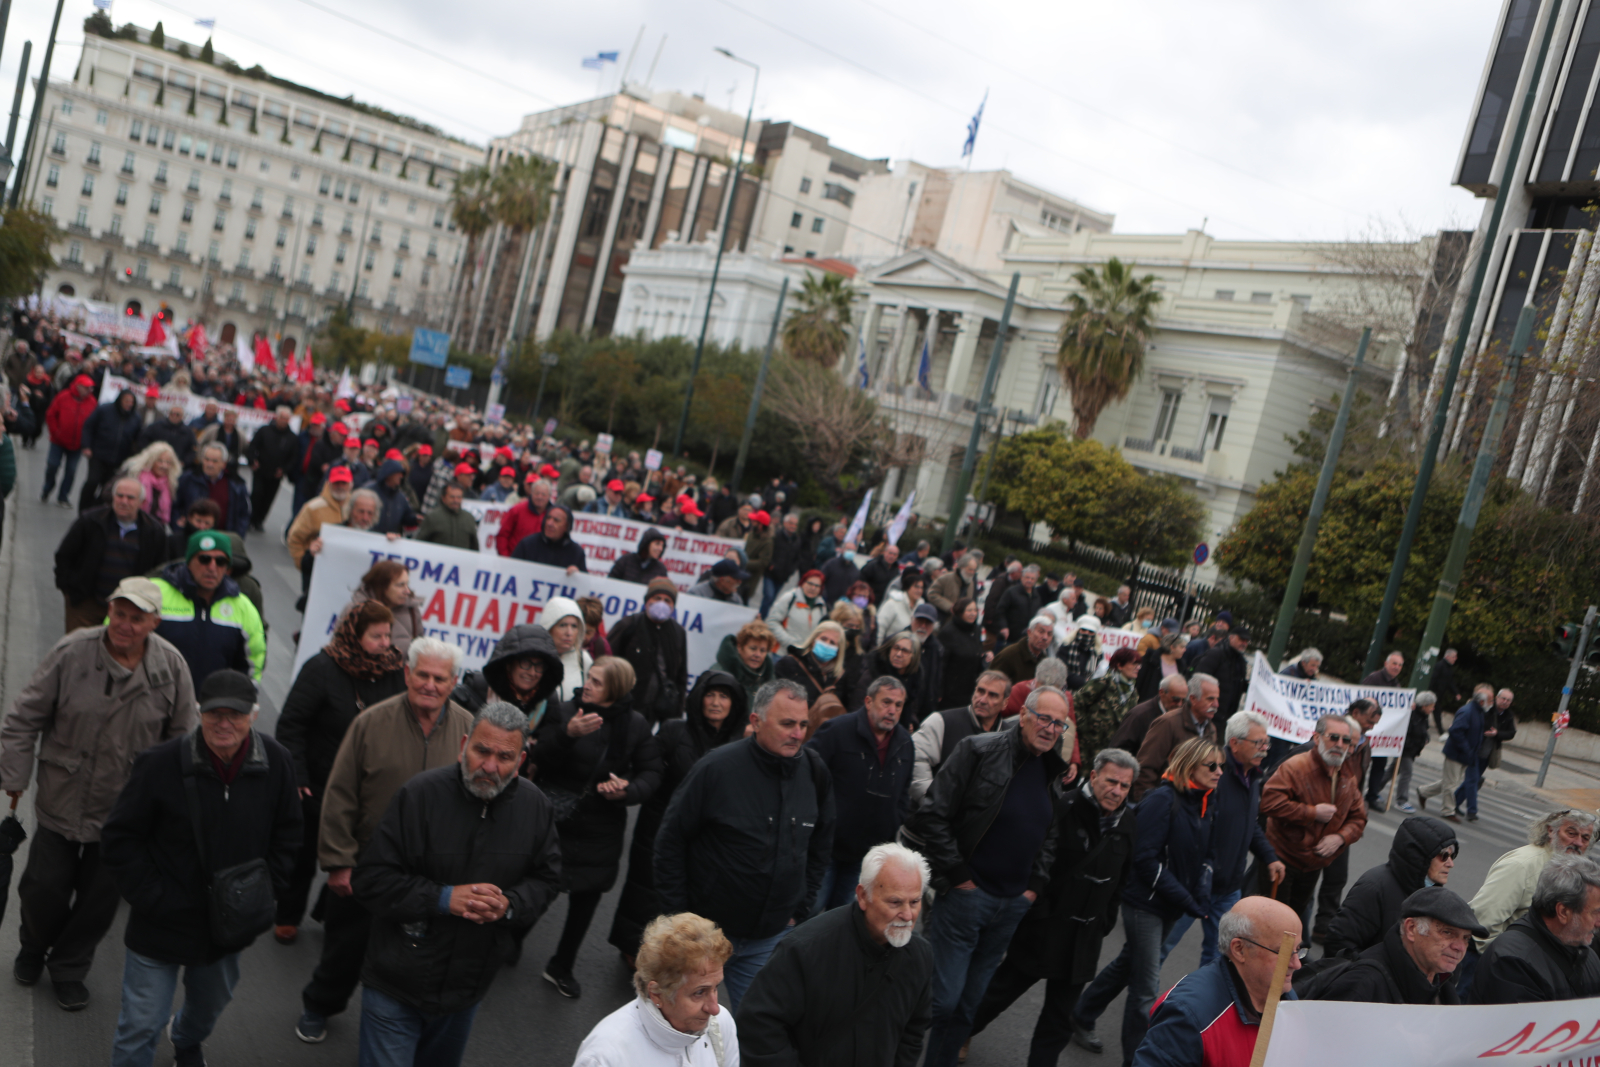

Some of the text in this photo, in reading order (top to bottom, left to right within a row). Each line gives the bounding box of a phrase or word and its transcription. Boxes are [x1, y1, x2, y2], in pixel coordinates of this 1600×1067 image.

[473, 569, 517, 597] ΠΙΑ
[529, 580, 577, 602] ΣΤΗ
[422, 588, 543, 634] ΑΠΑΙΤ
